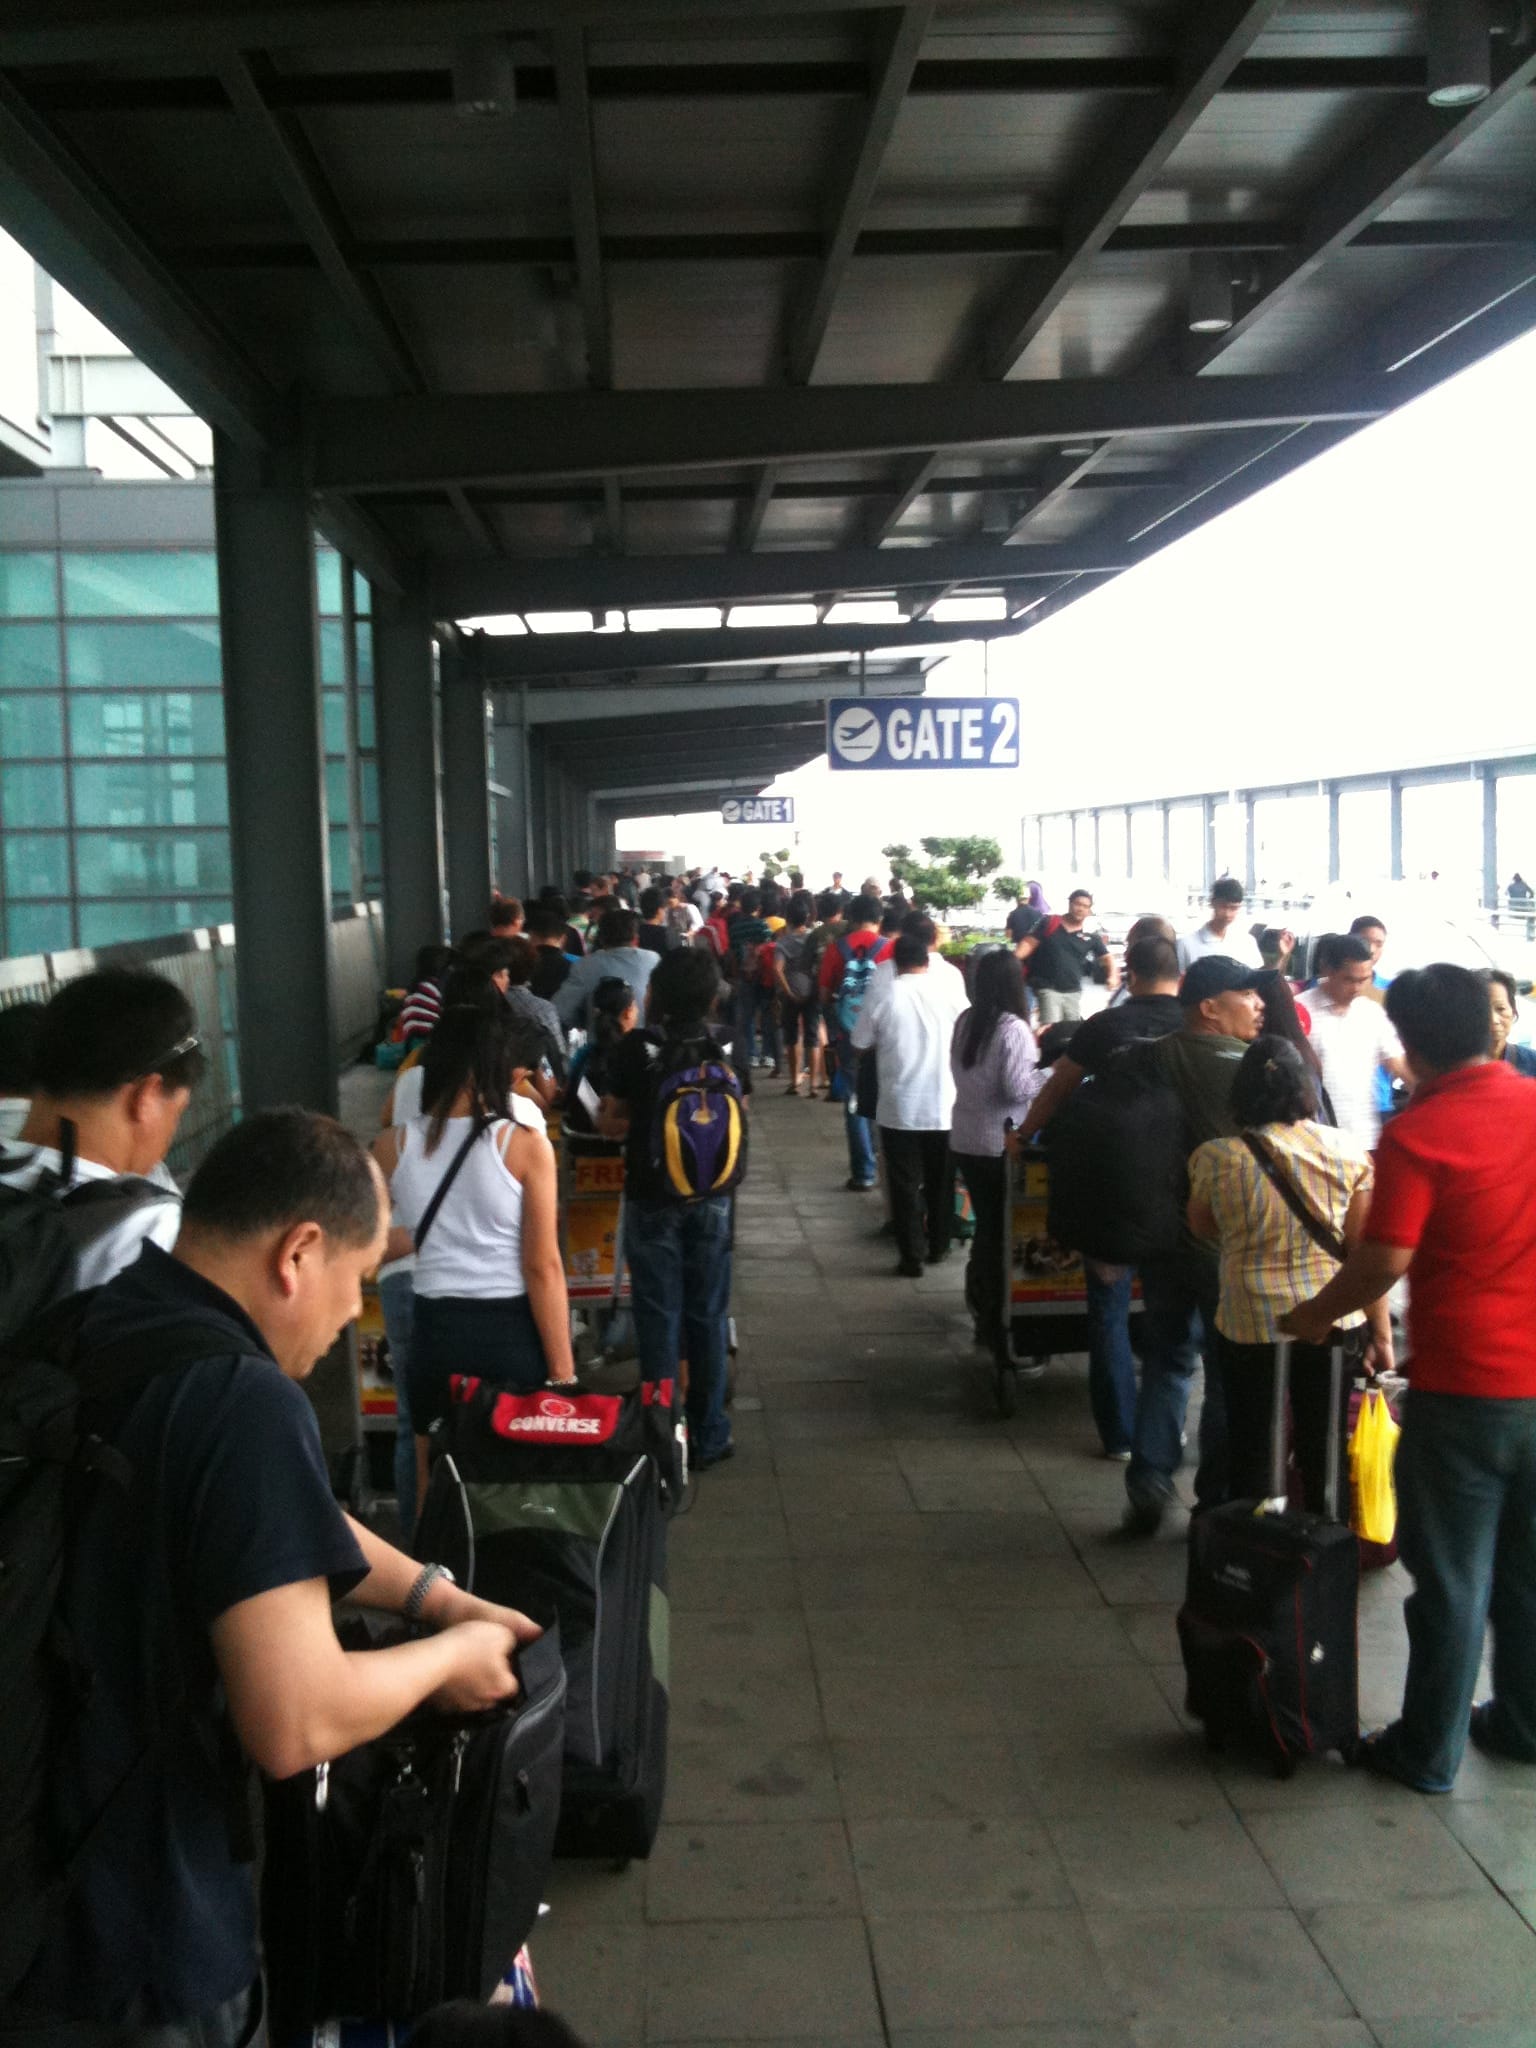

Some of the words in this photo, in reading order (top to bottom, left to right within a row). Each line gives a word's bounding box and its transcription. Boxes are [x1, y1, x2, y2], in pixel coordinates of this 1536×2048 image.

[886, 707, 984, 761] GATE
[989, 702, 1017, 764] 2
[742, 799, 782, 822] GATE
[783, 798, 793, 822] 1
[509, 1416, 601, 1434] CONVERSE
